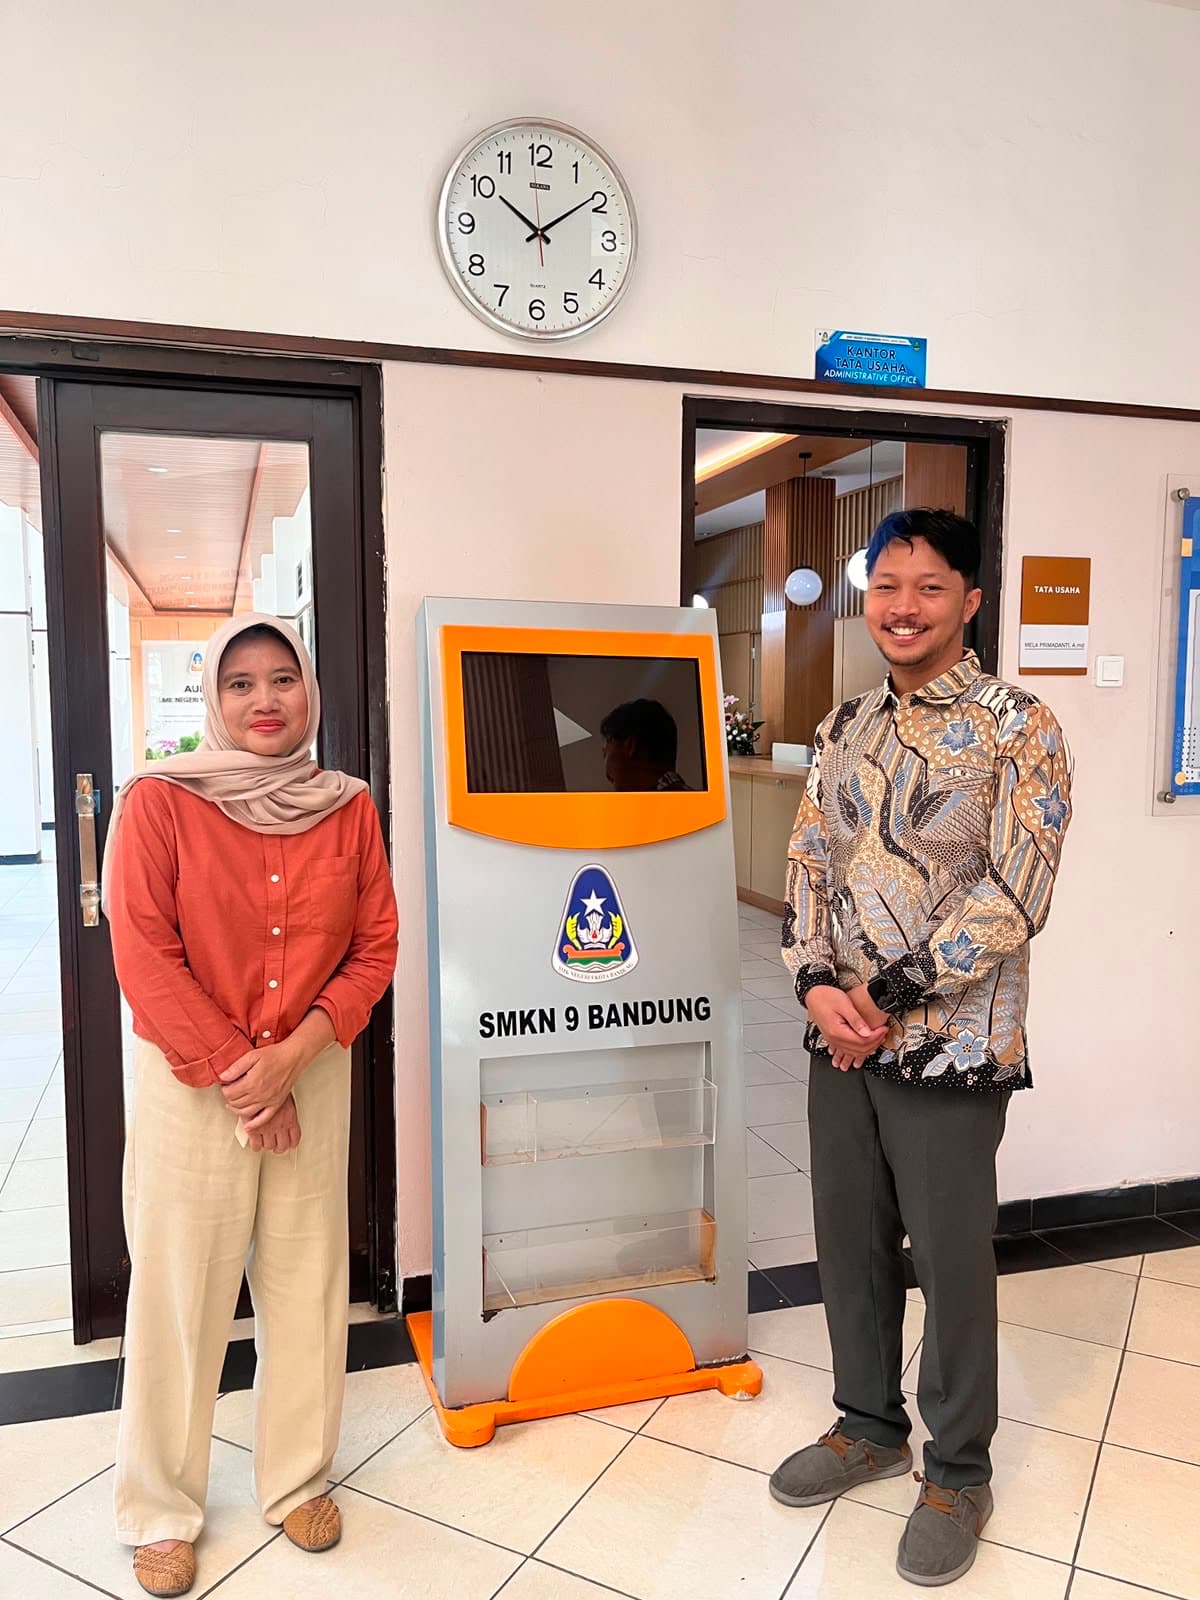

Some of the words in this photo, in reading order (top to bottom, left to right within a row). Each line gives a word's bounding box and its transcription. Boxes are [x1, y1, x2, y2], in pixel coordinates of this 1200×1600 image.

[497, 151, 512, 174] 11
[528, 143, 553, 168] 12
[572, 161, 579, 184] 1
[470, 174, 496, 198] 10
[591, 191, 608, 214] 2
[457, 212, 475, 235] 9
[601, 230, 617, 252] 3
[468, 254, 485, 276] 8
[588, 268, 605, 290] 4
[493, 284, 510, 307] 7
[563, 292, 579, 314] 5
[529, 299, 545, 321] 6
[847, 345, 896, 359] KANTOR
[835, 357, 862, 369] TATA
[867, 360, 907, 373] USAHA
[824, 369, 889, 382] ADMINISTRATIVE
[890, 374, 918, 384] OFFICE
[1034, 585, 1053, 593] TATA
[1055, 586, 1080, 594] USAHA
[479, 1007, 556, 1038] SMKN
[564, 1006, 579, 1032] 9
[588, 996, 711, 1030] BANDUNG
